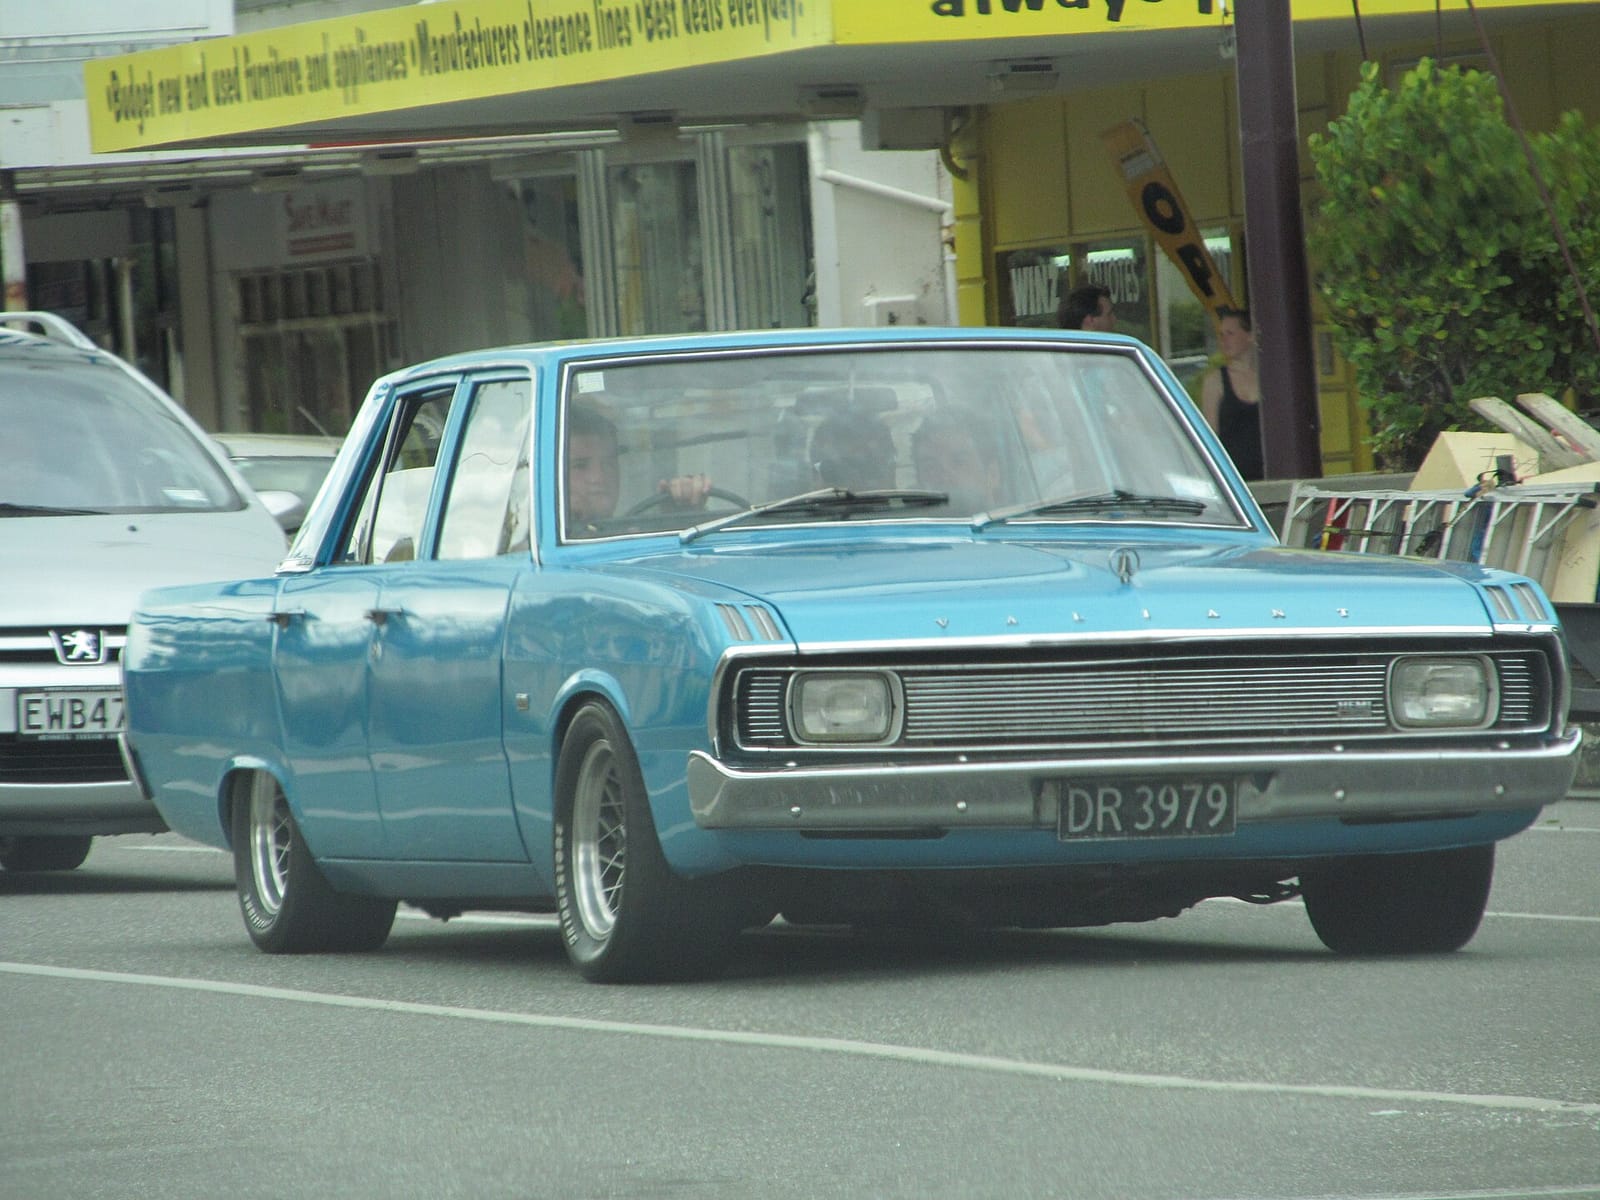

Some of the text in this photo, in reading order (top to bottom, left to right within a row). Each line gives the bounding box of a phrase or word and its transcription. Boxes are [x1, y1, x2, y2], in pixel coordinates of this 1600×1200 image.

[110, 64, 155, 136] Budget
[158, 74, 182, 115] new
[185, 52, 210, 111] and
[212, 46, 242, 106] used
[242, 45, 303, 102] furniture
[305, 32, 331, 93] and
[333, 26, 408, 105] appliances
[415, 10, 521, 77] Manufacturers
[523, 0, 592, 61] clearance
[593, 0, 632, 50] lines
[1010, 261, 1061, 317] WINZ
[1068, 783, 1228, 833] DR 3979
